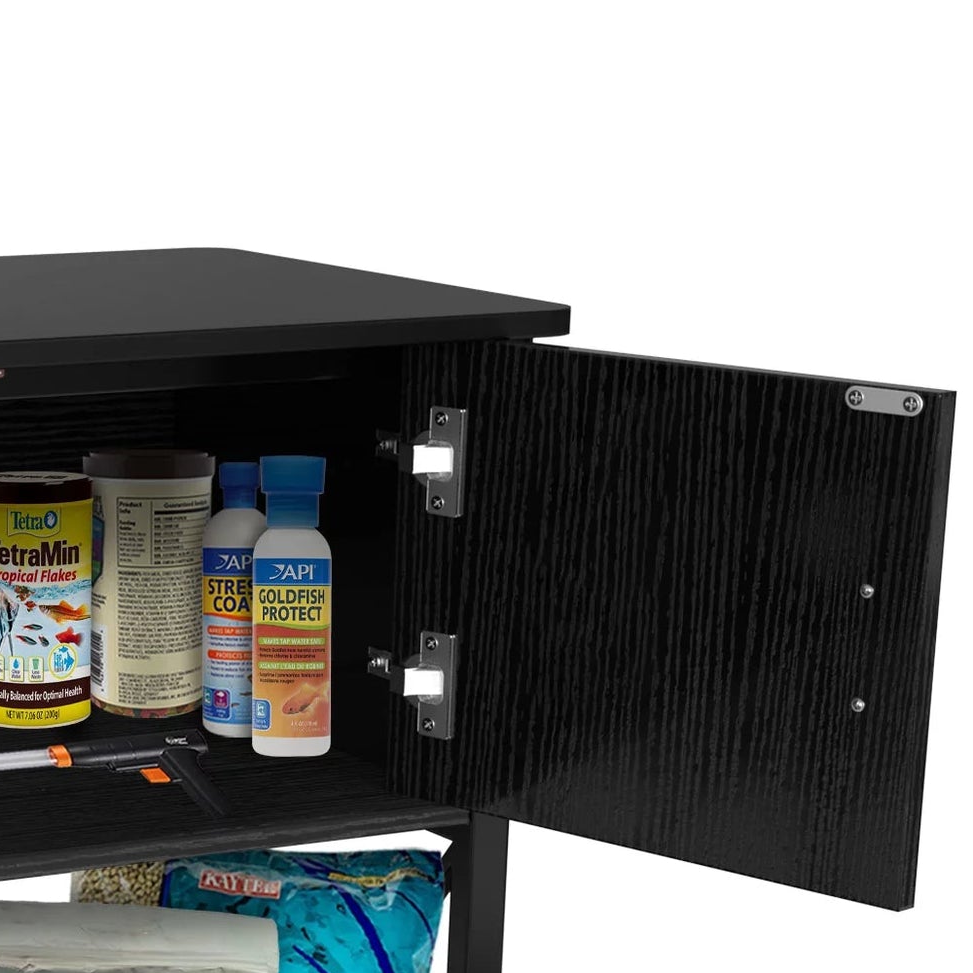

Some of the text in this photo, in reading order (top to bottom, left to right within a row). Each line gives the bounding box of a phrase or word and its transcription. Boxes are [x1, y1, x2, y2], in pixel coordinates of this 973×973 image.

[10, 511, 43, 530] Tetra
[226, 554, 252, 570] AP
[40, 568, 77, 582] Flakes
[281, 564, 314, 580] API
[213, 596, 253, 612] COA
[259, 588, 325, 604] GOLDFISH
[262, 605, 322, 621] PROTECT
[10, 690, 33, 701] Balanced
[34, 691, 42, 701] for
[43, 690, 64, 702] Optimal
[65, 685, 83, 697] Health
